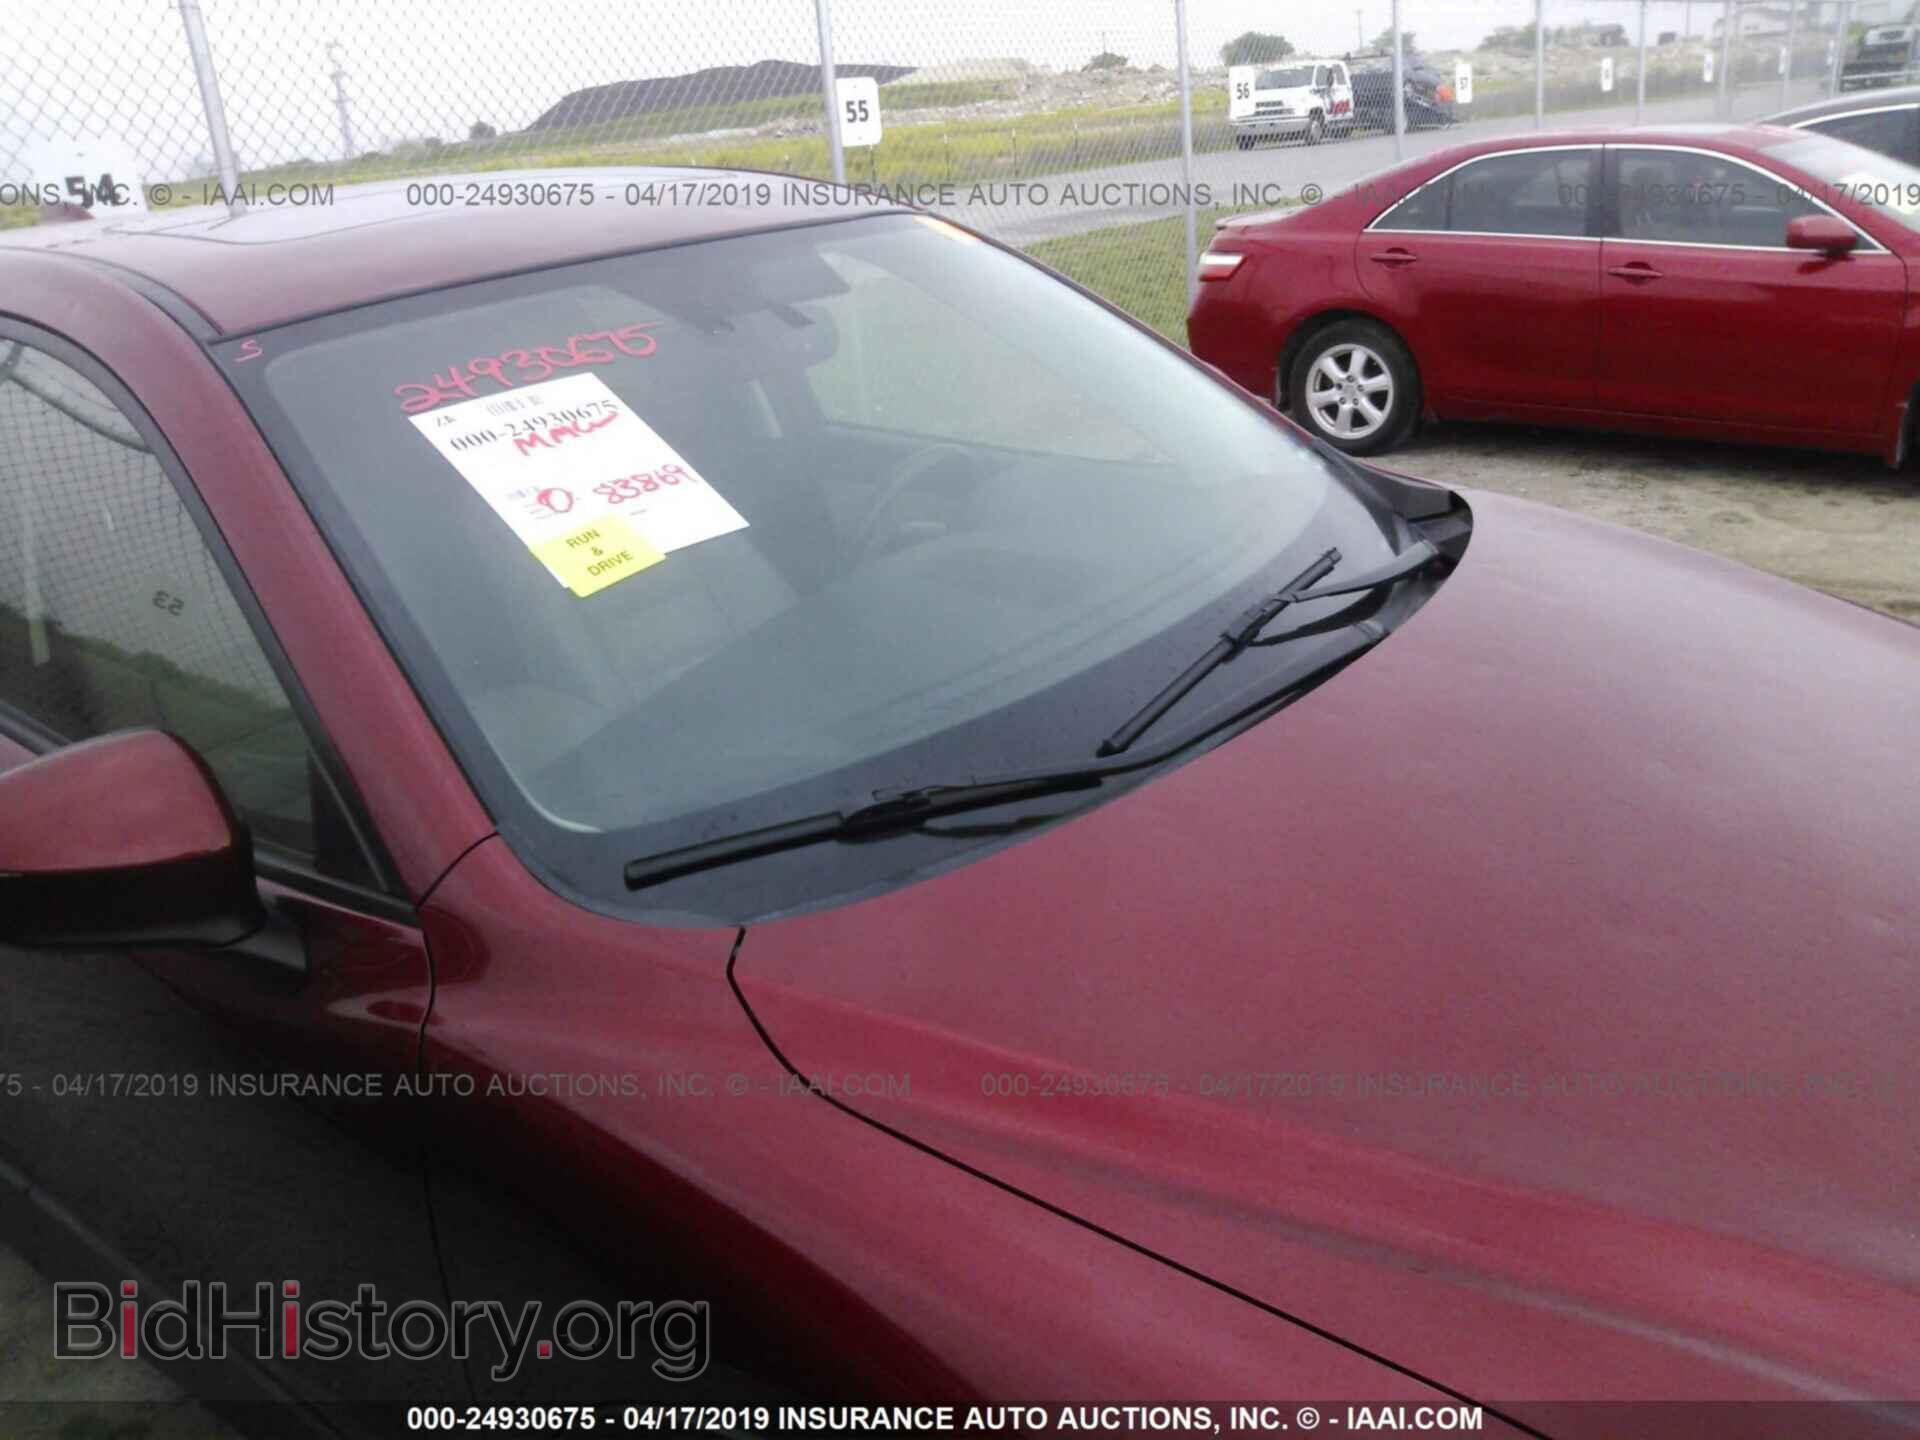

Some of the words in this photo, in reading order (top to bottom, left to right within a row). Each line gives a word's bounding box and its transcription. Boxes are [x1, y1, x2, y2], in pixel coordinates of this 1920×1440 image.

[1236, 81, 1251, 100] 56
[845, 99, 869, 123] 55
[65, 172, 122, 209] 54
[394, 320, 665, 414] 24930675
[450, 398, 619, 452] 000-24930675
[592, 463, 699, 505] 83869
[565, 527, 602, 550] RUN
[591, 545, 604, 558] &
[587, 550, 635, 578] DRIVE
